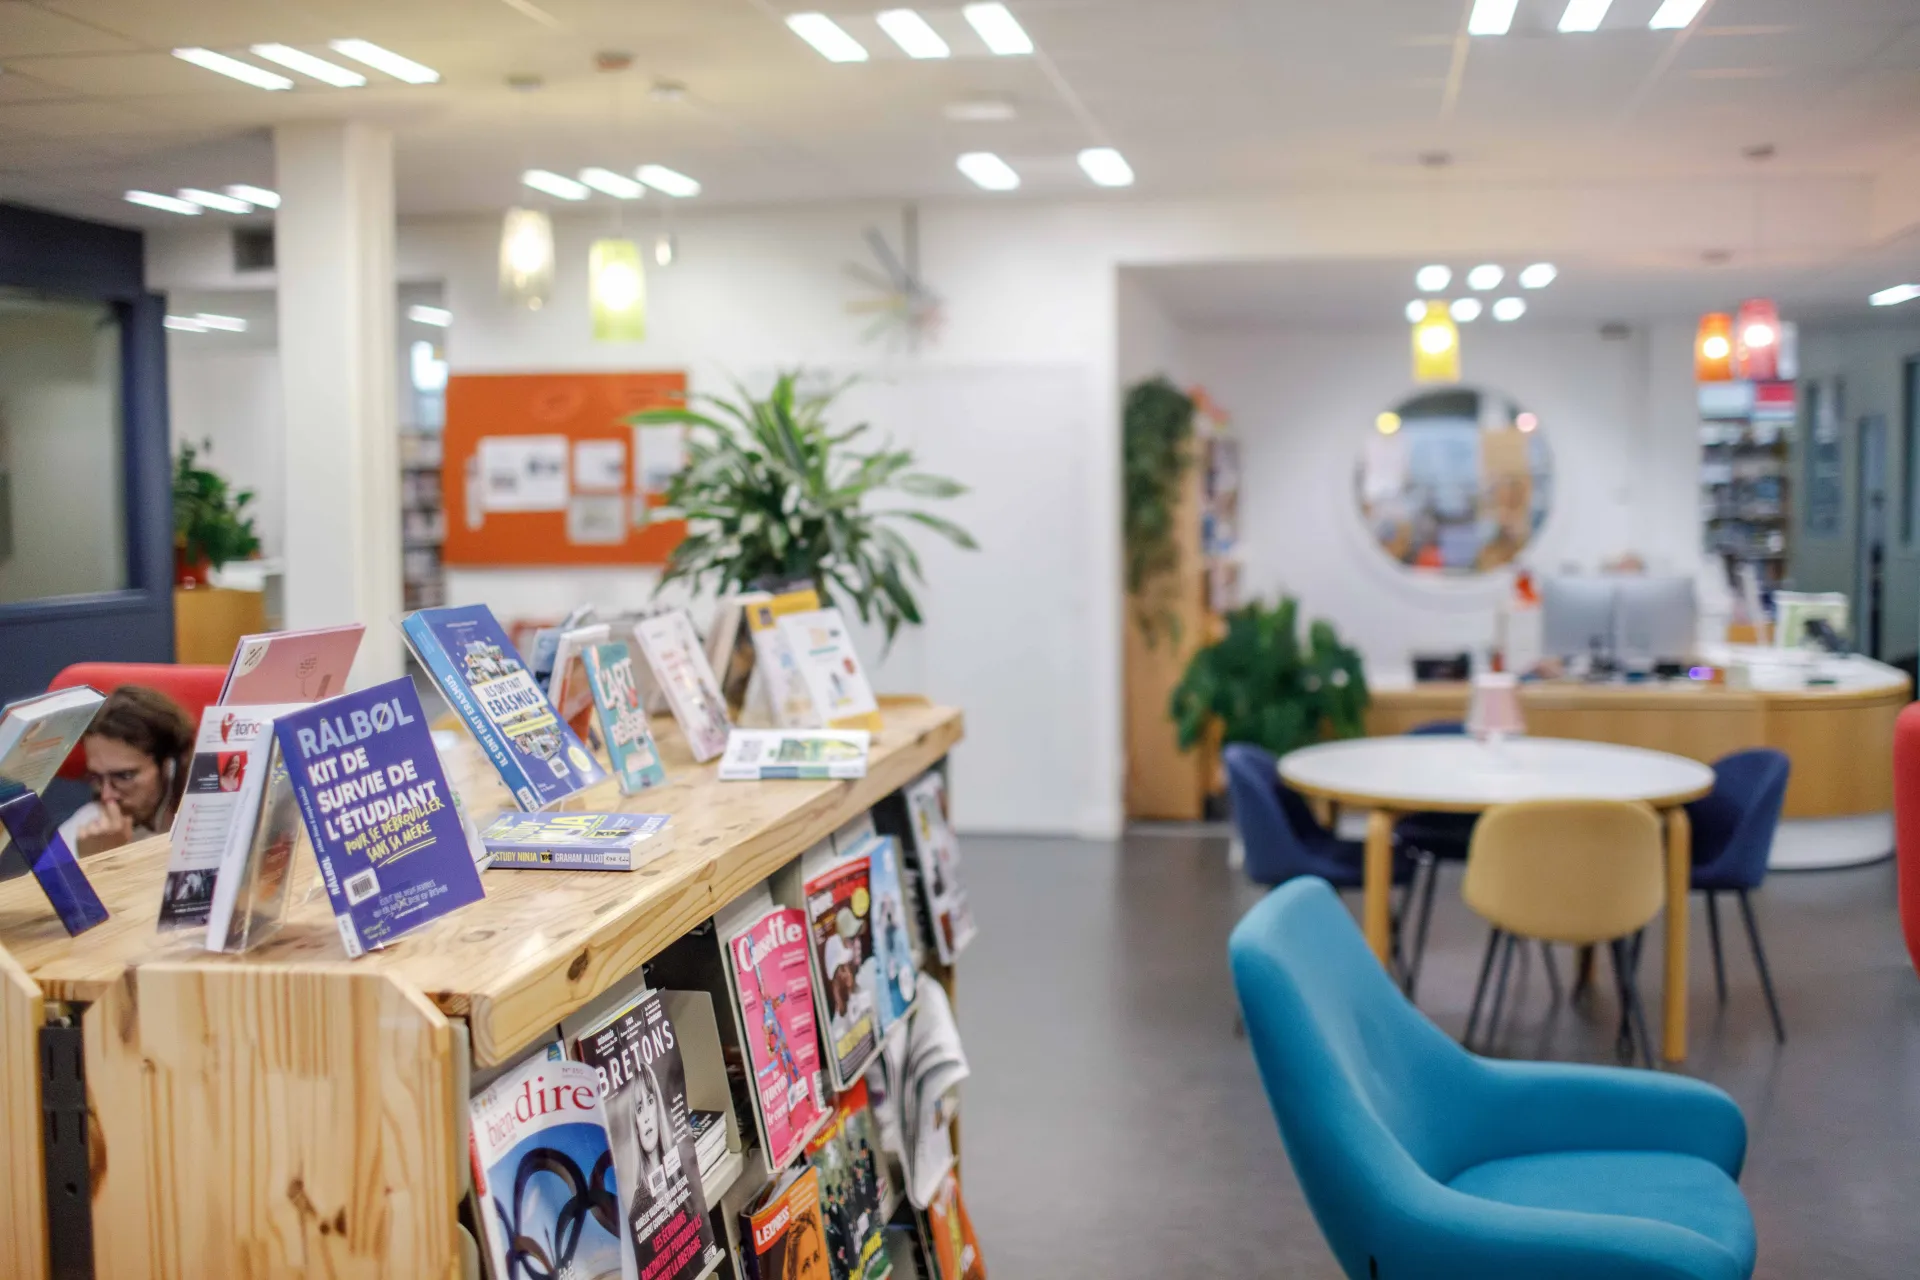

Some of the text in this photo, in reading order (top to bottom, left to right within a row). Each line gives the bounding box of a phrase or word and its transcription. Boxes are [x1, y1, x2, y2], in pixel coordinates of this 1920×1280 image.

[484, 684, 497, 698] ILS
[487, 687, 539, 717] ERASMUS
[445, 674, 508, 767] ILS ONT FAIT ERASMUS
[308, 747, 370, 786] KIT DE
[316, 770, 387, 814] SURVIE
[387, 759, 418, 787] DE
[324, 780, 437, 841] L'ÉTUDIANT
[344, 833, 371, 856] POUR
[368, 826, 382, 843] SE
[366, 840, 390, 863] SANS
[388, 834, 402, 851] SA
[495, 851, 516, 861] STUDY
[517, 852, 538, 862] NINJA
[555, 854, 582, 863] GRAHAM
[595, 1020, 674, 1098] BRETONS
